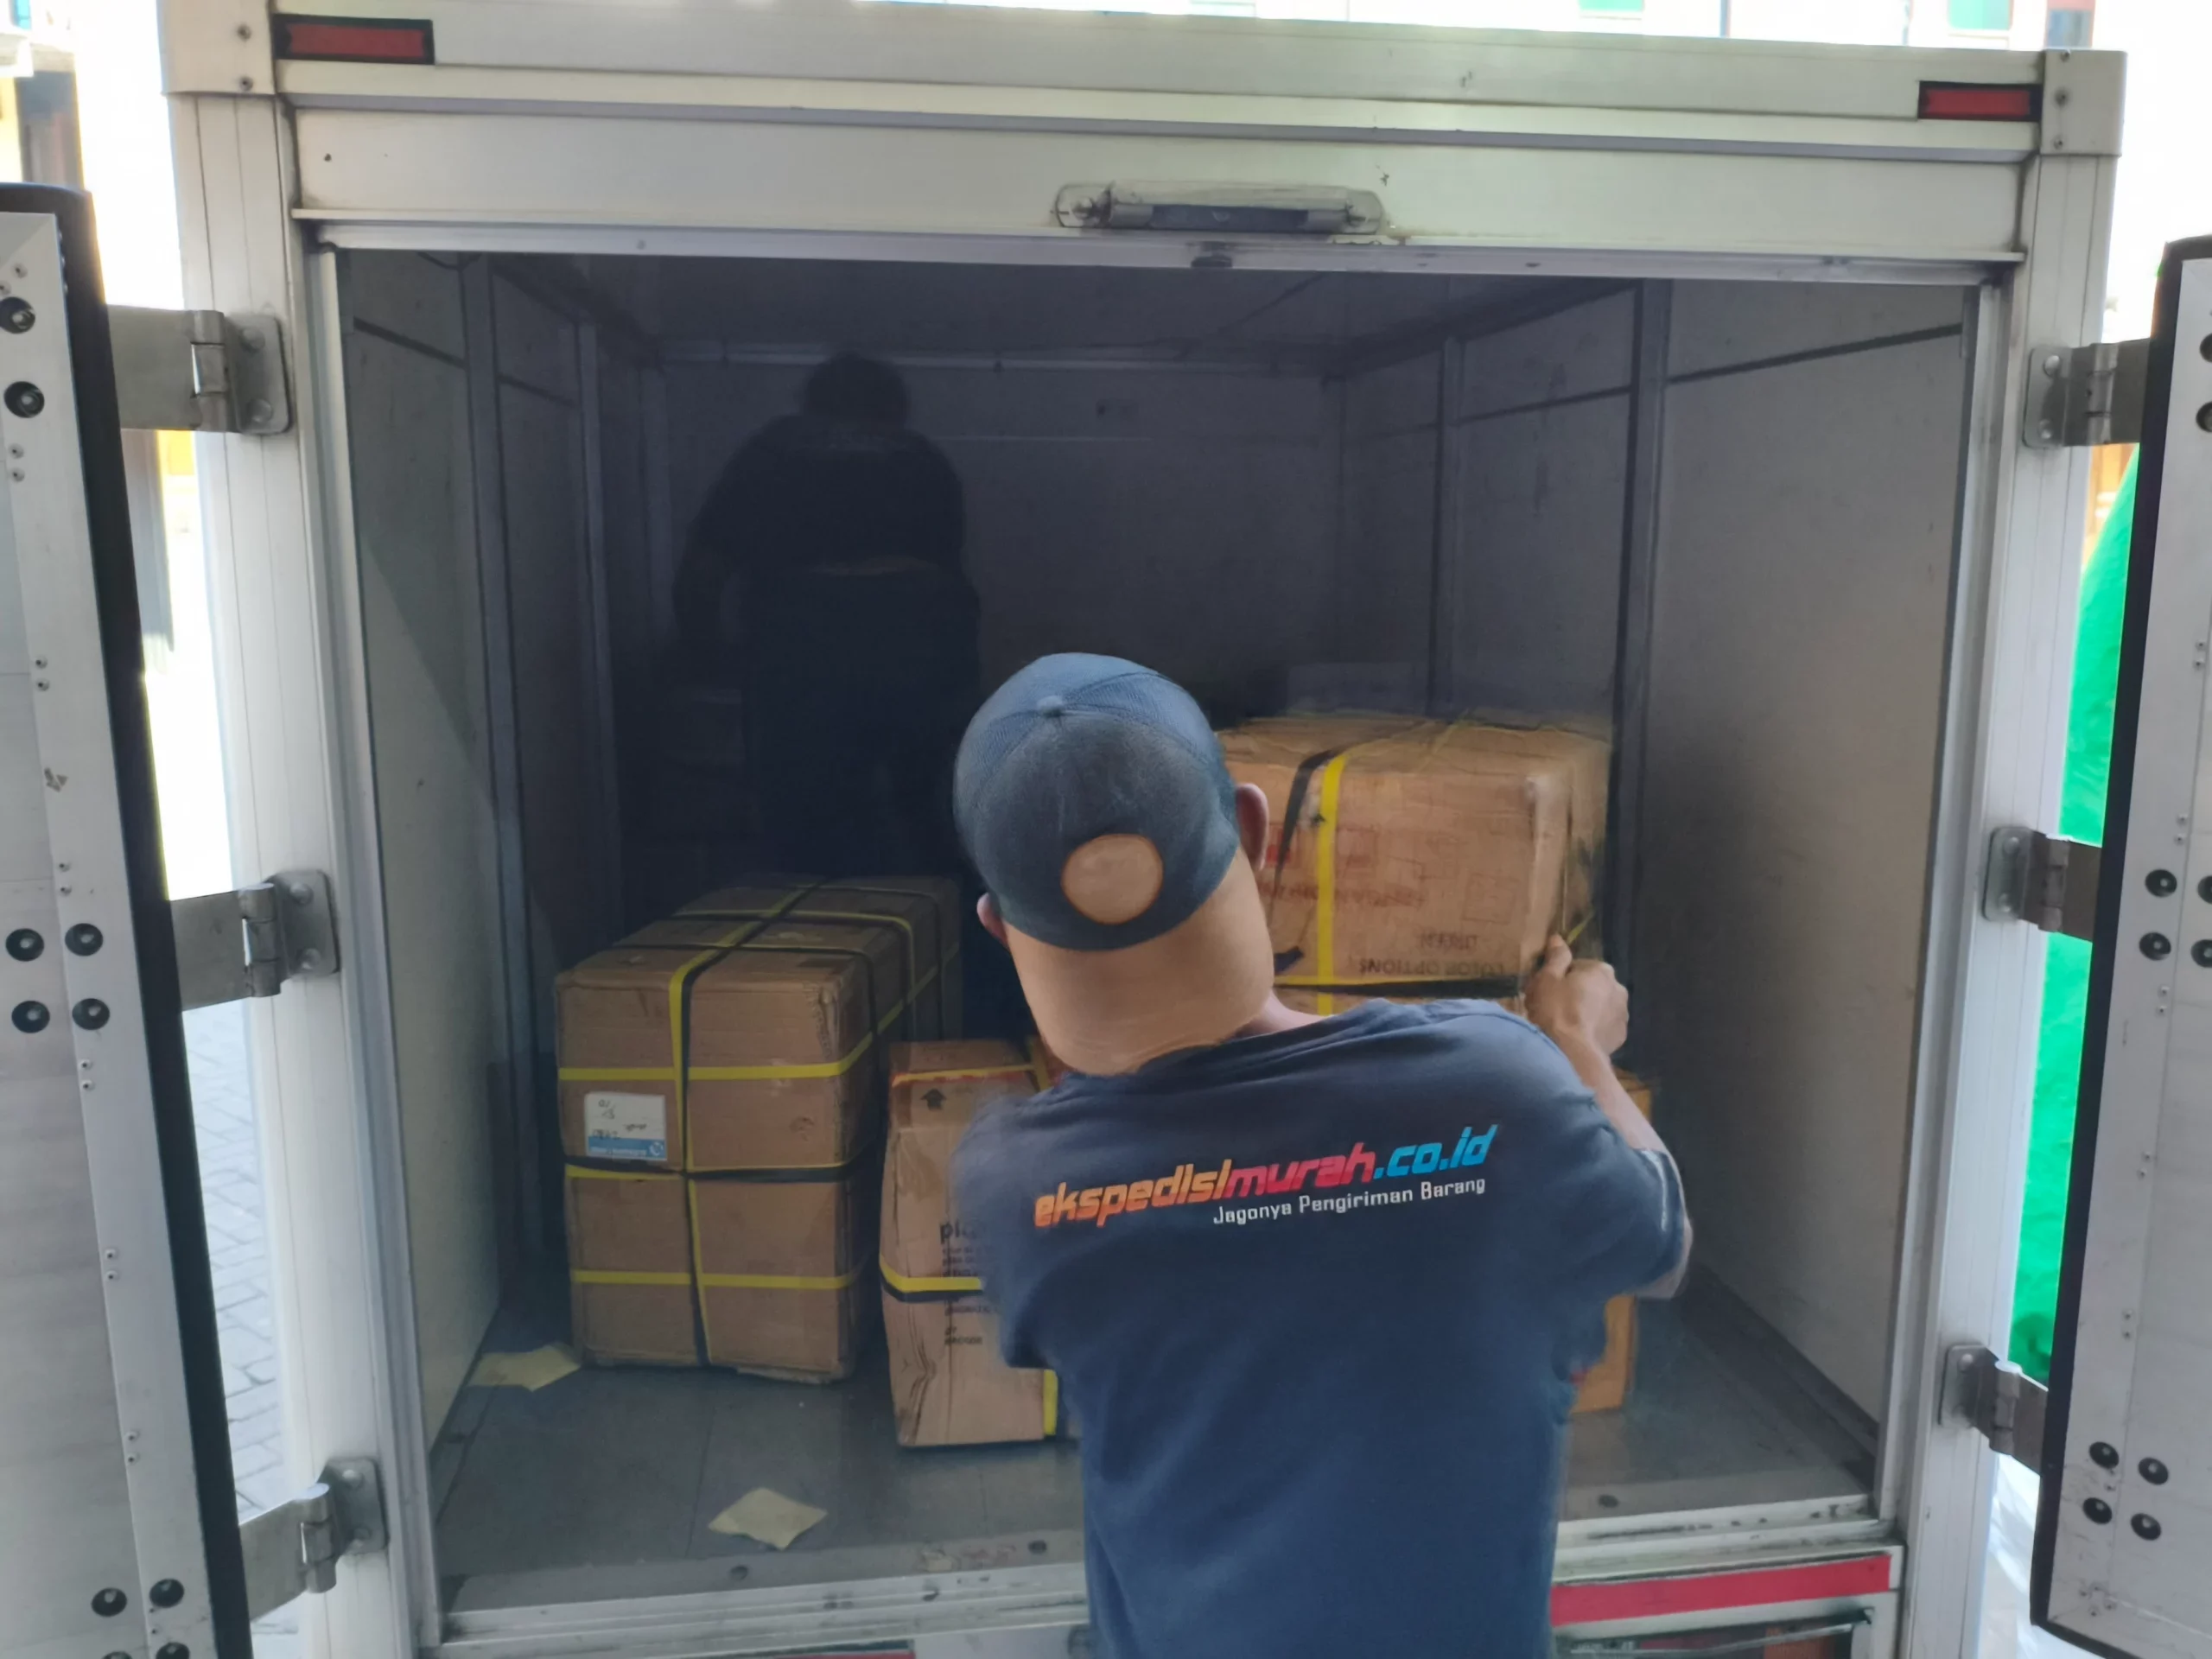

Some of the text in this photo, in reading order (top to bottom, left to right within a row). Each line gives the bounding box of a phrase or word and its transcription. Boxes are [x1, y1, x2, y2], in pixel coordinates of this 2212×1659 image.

[1358, 958, 1440, 976] OPTIONS
[1213, 1178, 1485, 1225] Jagonya Pengiriman Barang
